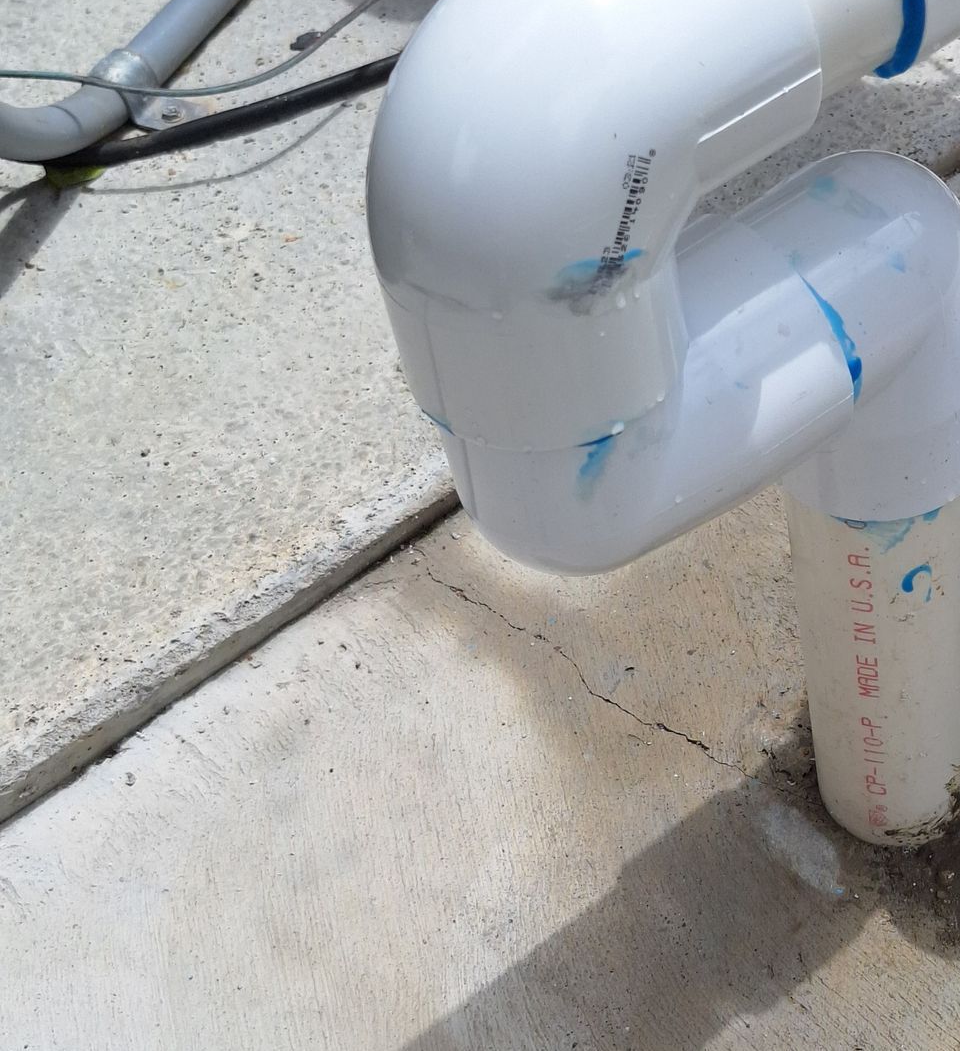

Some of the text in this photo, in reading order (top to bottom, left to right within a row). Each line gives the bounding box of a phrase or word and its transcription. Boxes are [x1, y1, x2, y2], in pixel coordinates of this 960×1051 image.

[847, 547, 874, 613] U.S.A.
[853, 622, 876, 645] IN
[856, 654, 881, 699] MADE
[861, 716, 887, 796] CP-110-P
